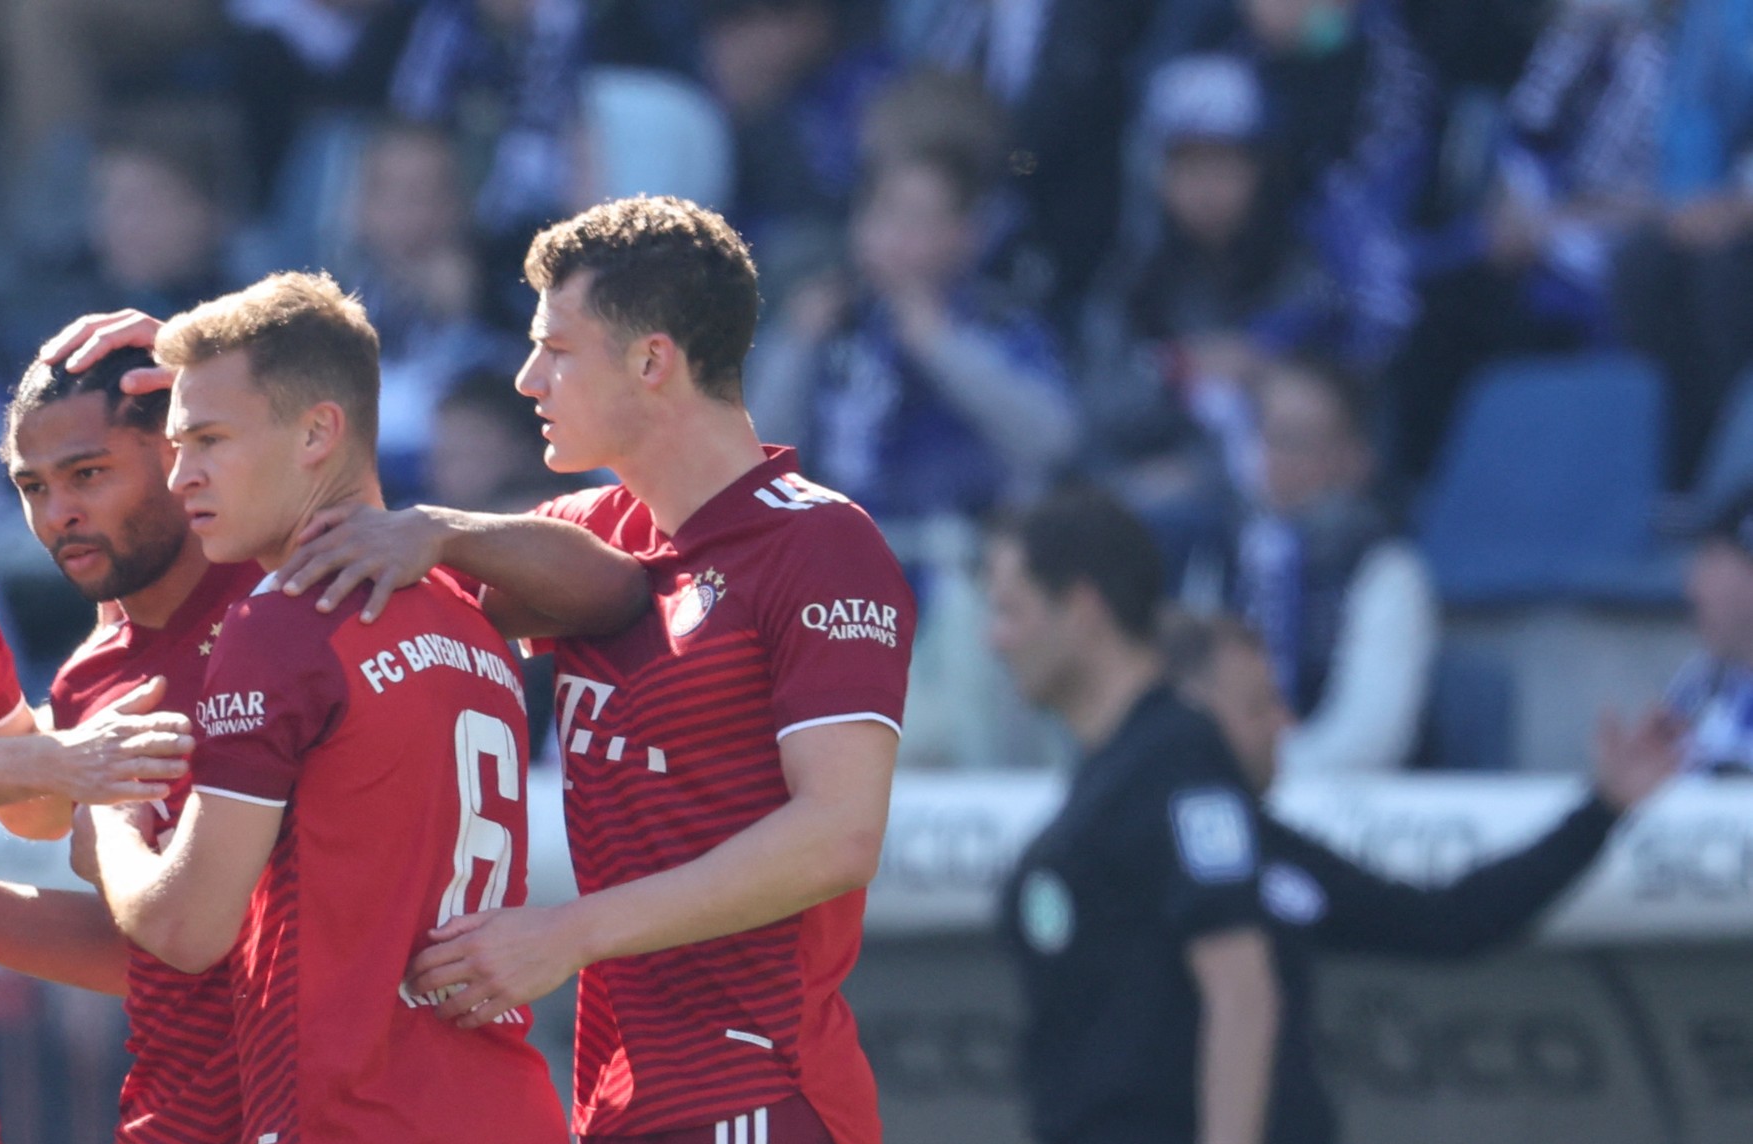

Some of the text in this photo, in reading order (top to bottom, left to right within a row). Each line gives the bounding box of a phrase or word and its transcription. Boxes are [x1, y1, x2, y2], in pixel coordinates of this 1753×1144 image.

[801, 599, 897, 632] QATAR
[828, 624, 897, 648] AIRWAYS
[359, 650, 405, 694] FC
[398, 633, 473, 673] BAYERN
[196, 691, 265, 728] QATAR
[207, 717, 264, 737] AIRWAYS
[436, 709, 519, 929] 6
